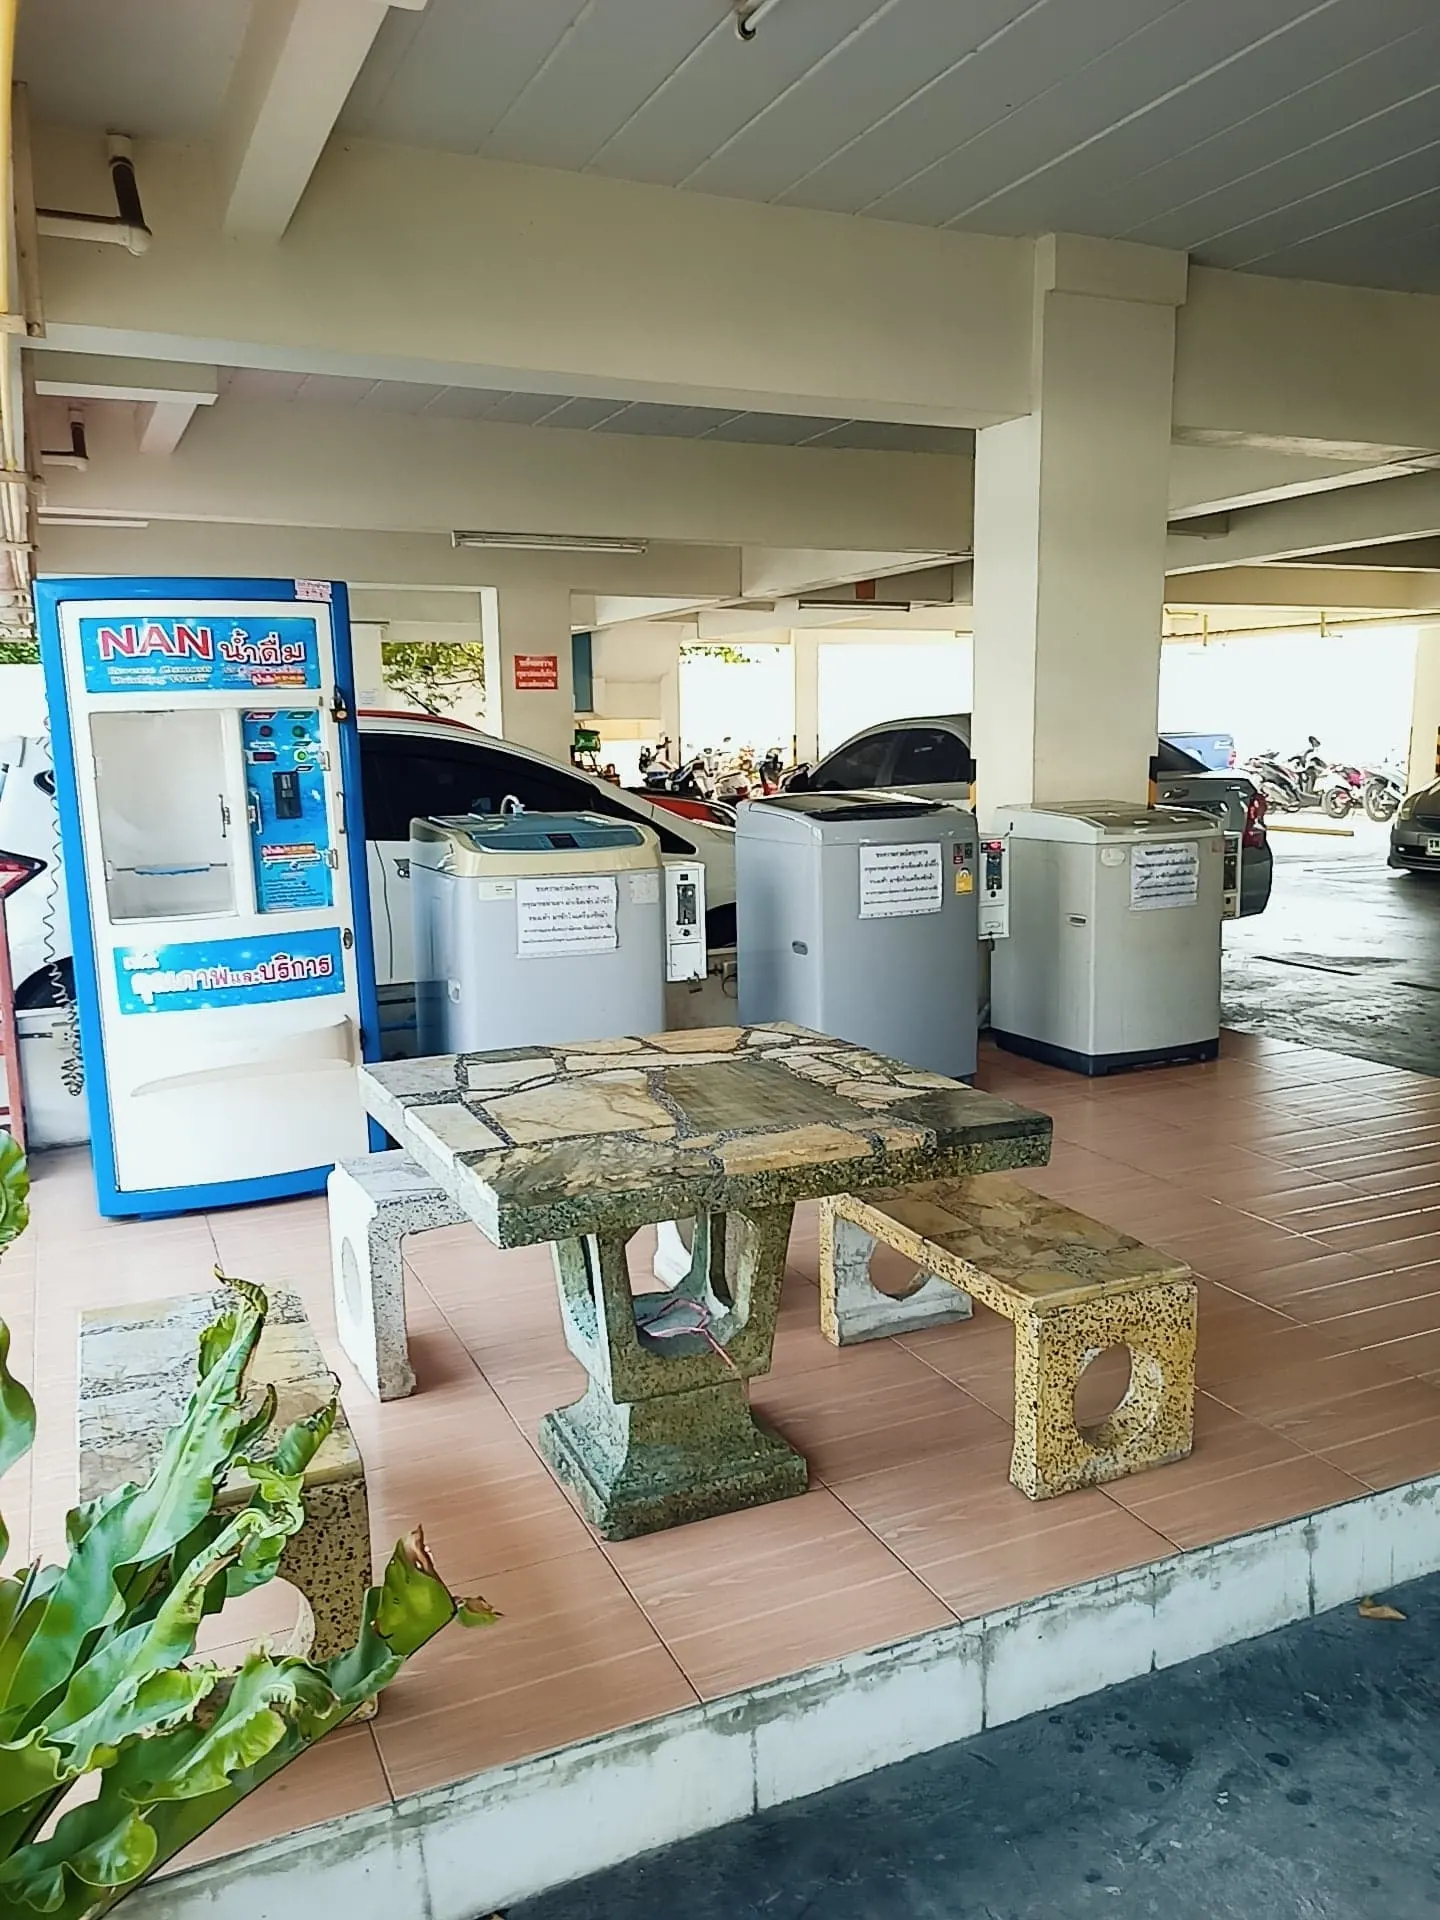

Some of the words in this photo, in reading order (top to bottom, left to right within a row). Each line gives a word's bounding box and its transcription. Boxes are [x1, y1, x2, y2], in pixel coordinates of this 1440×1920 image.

[98, 625, 212, 660] NAN
[218, 628, 305, 665] น้ำดื่ม
